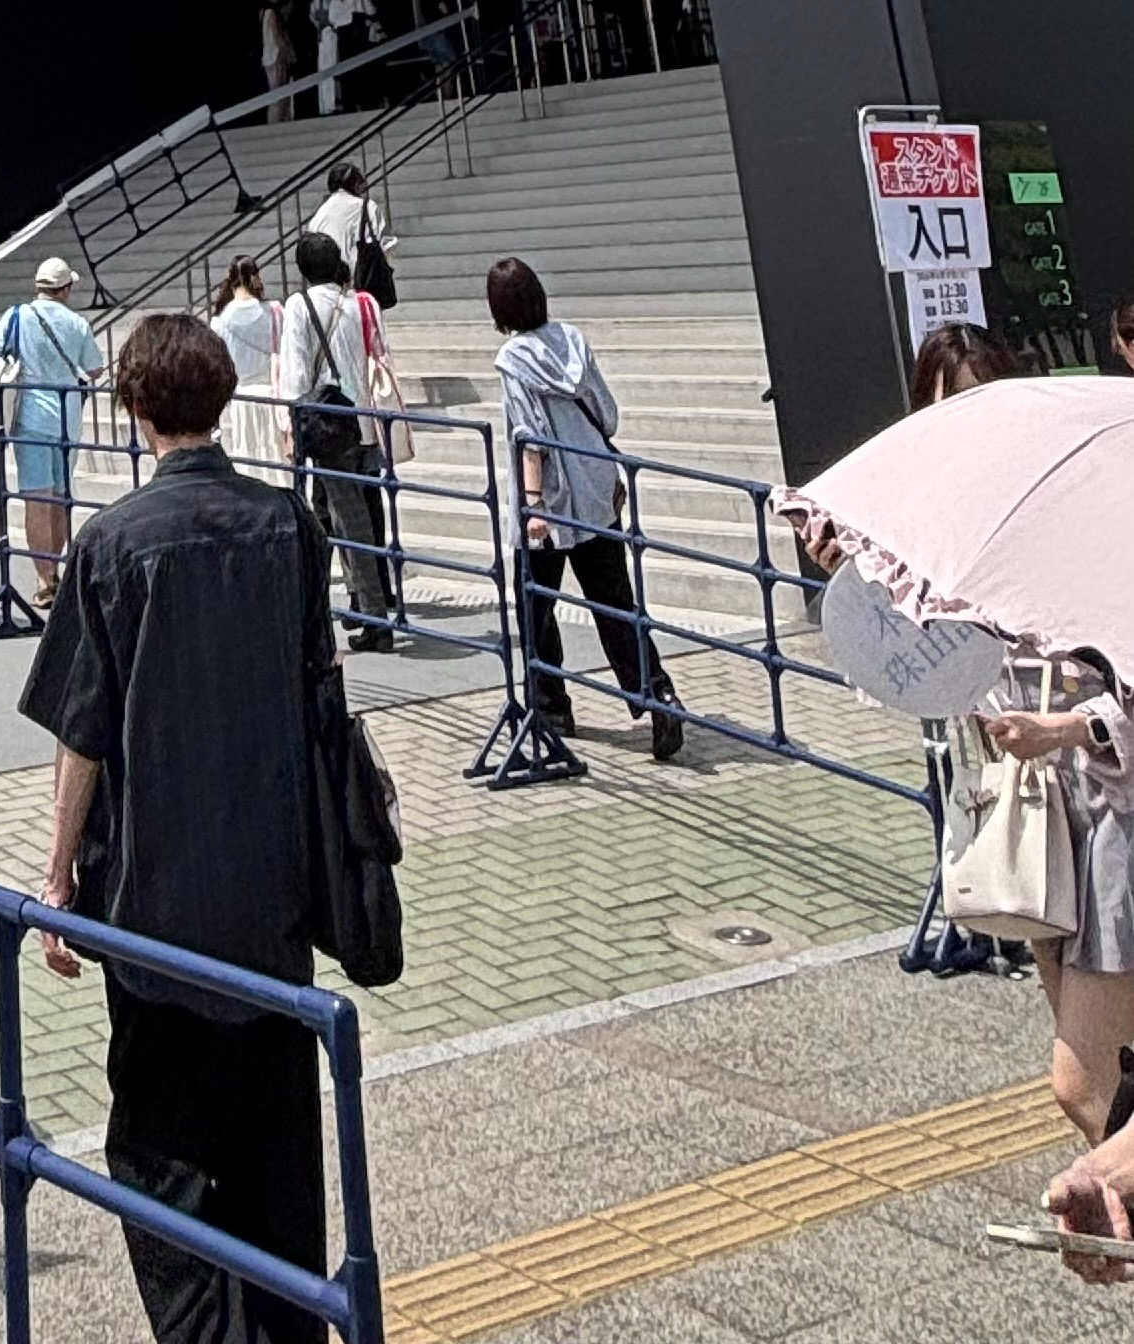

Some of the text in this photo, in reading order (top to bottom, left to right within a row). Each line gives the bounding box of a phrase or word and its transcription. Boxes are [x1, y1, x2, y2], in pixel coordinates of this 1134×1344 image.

[893, 136, 959, 164] スタンド
[879, 162, 978, 195] 通常チケット
[906, 204, 972, 261] 入口
[1024, 209, 1056, 236] GATE 1
[1051, 244, 1066, 270] 2
[1058, 278, 1072, 306] 3
